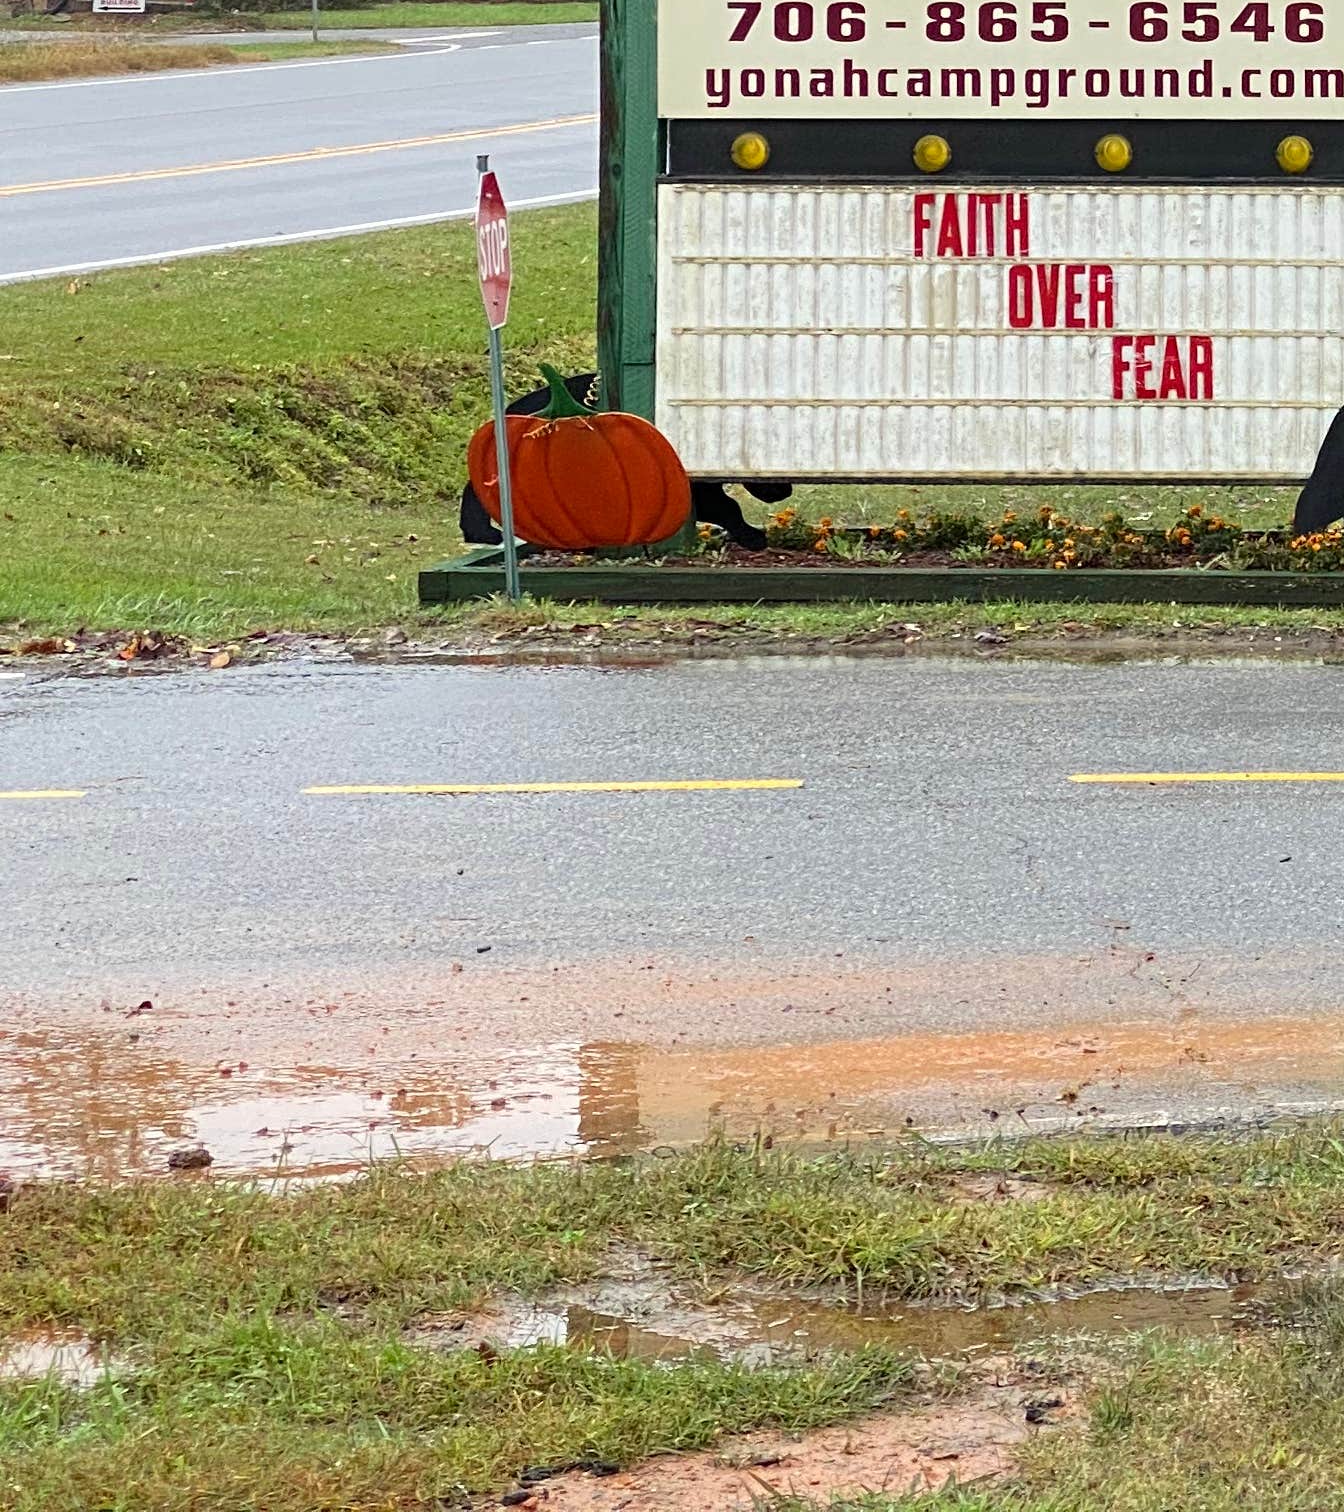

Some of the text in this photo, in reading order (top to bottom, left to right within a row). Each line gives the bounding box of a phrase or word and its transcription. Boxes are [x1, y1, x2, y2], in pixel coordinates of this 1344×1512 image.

[480, 218, 508, 282] STOP
[913, 192, 1030, 258] FAITH
[1007, 263, 1115, 330] OVER
[1111, 334, 1214, 401] FEAR
